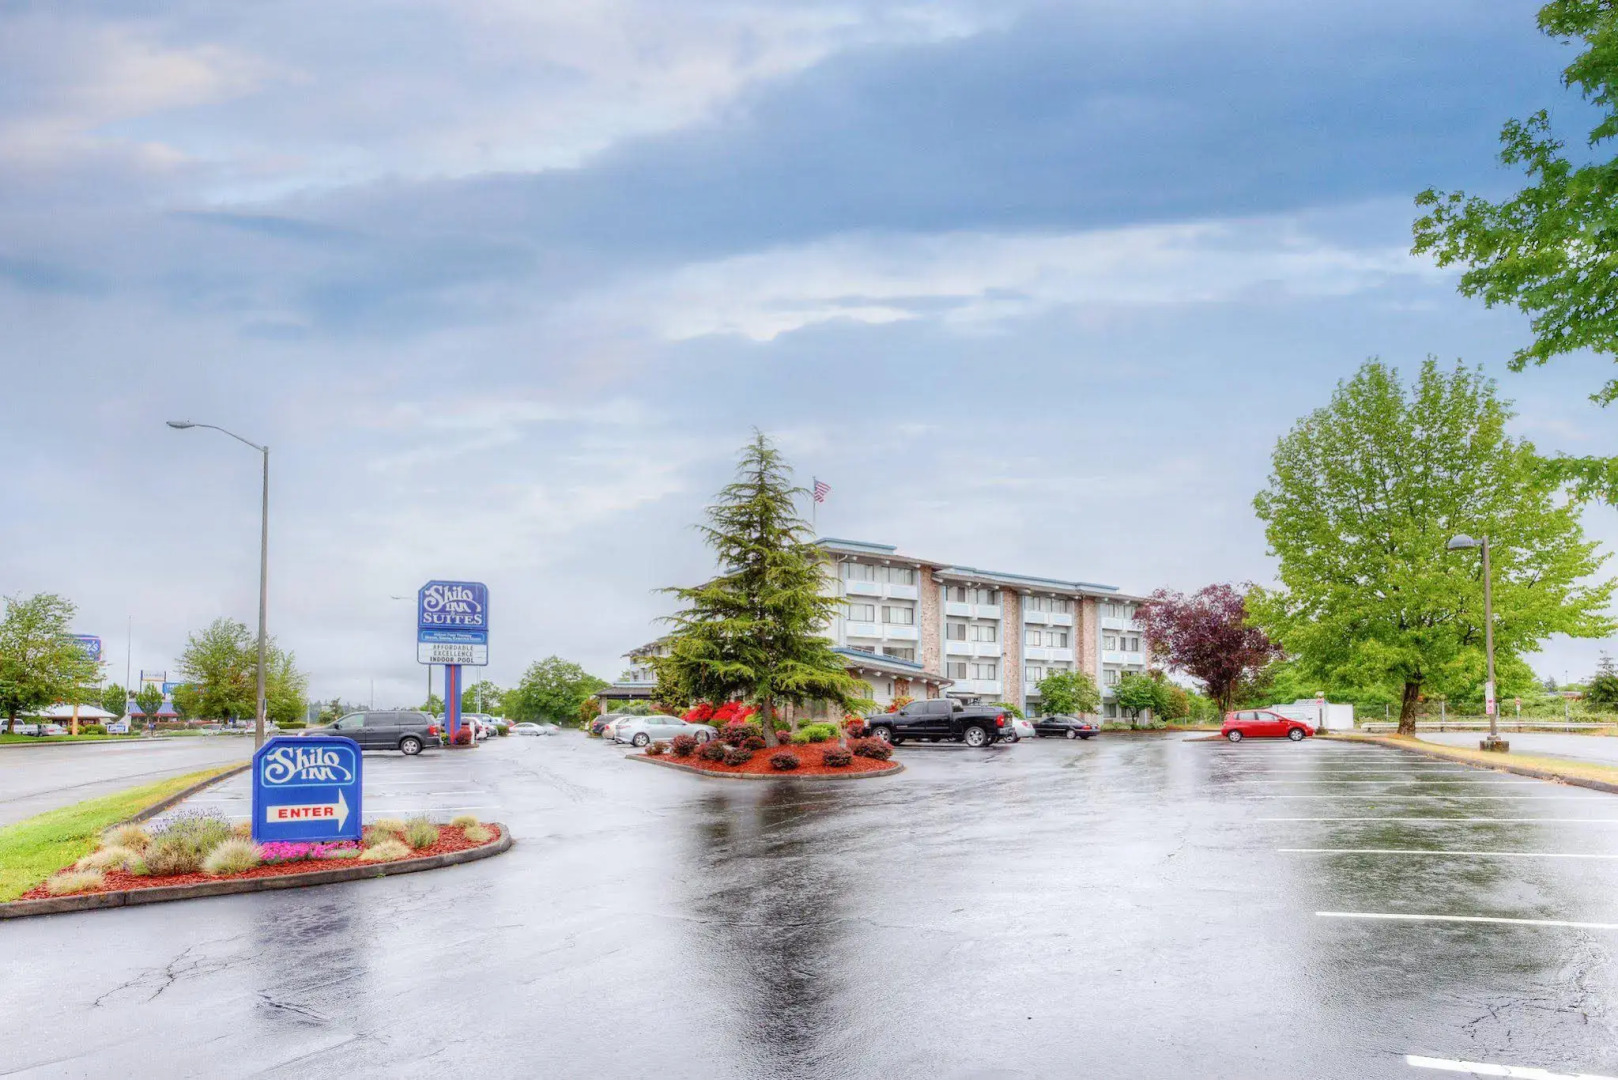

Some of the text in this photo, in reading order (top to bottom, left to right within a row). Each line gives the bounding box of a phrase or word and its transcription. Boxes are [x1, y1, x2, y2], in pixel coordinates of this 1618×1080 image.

[424, 585, 475, 612] Shilo
[423, 612, 482, 625] SUITES
[265, 747, 342, 784] Shilo
[278, 807, 334, 819] ENTER
